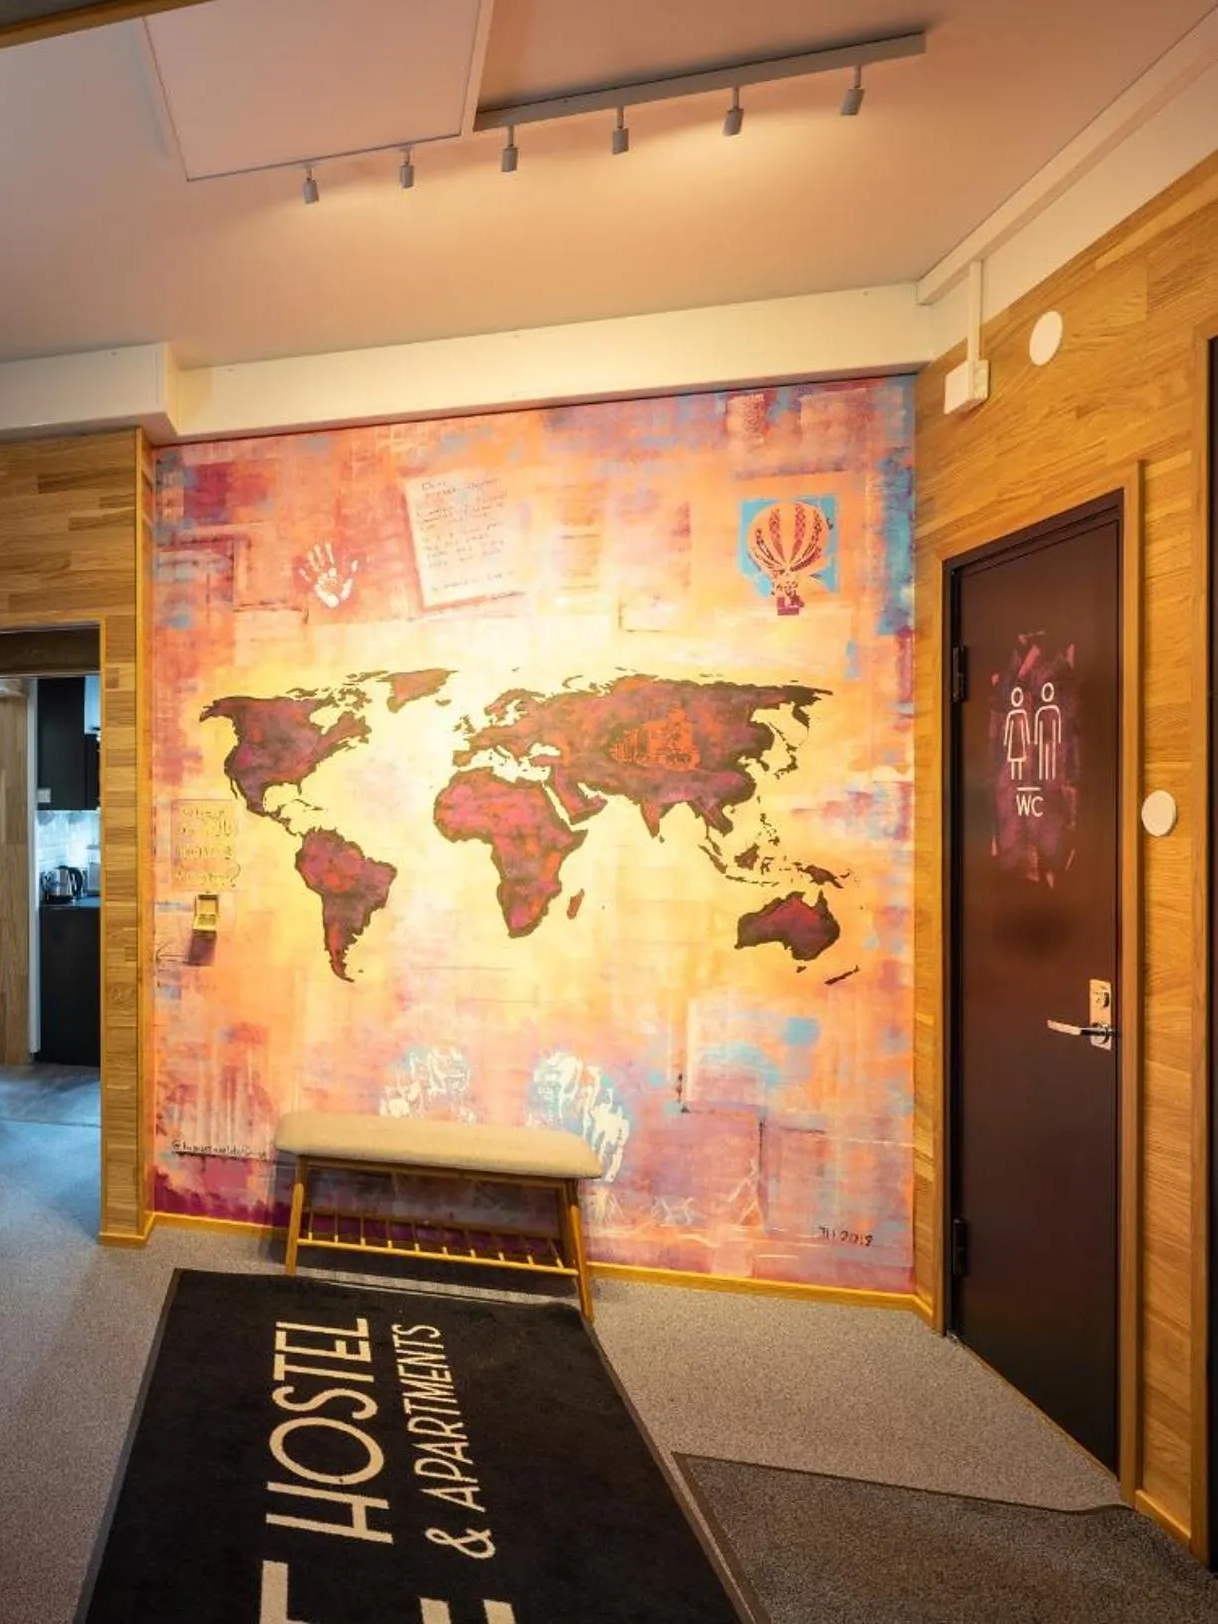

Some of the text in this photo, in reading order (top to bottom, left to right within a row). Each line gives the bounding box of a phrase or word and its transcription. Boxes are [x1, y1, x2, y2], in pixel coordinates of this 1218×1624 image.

[1016, 795, 1044, 818] WC
[266, 1317, 394, 1544] HOSTEL
[391, 1323, 497, 1559] & APARTMENTS
